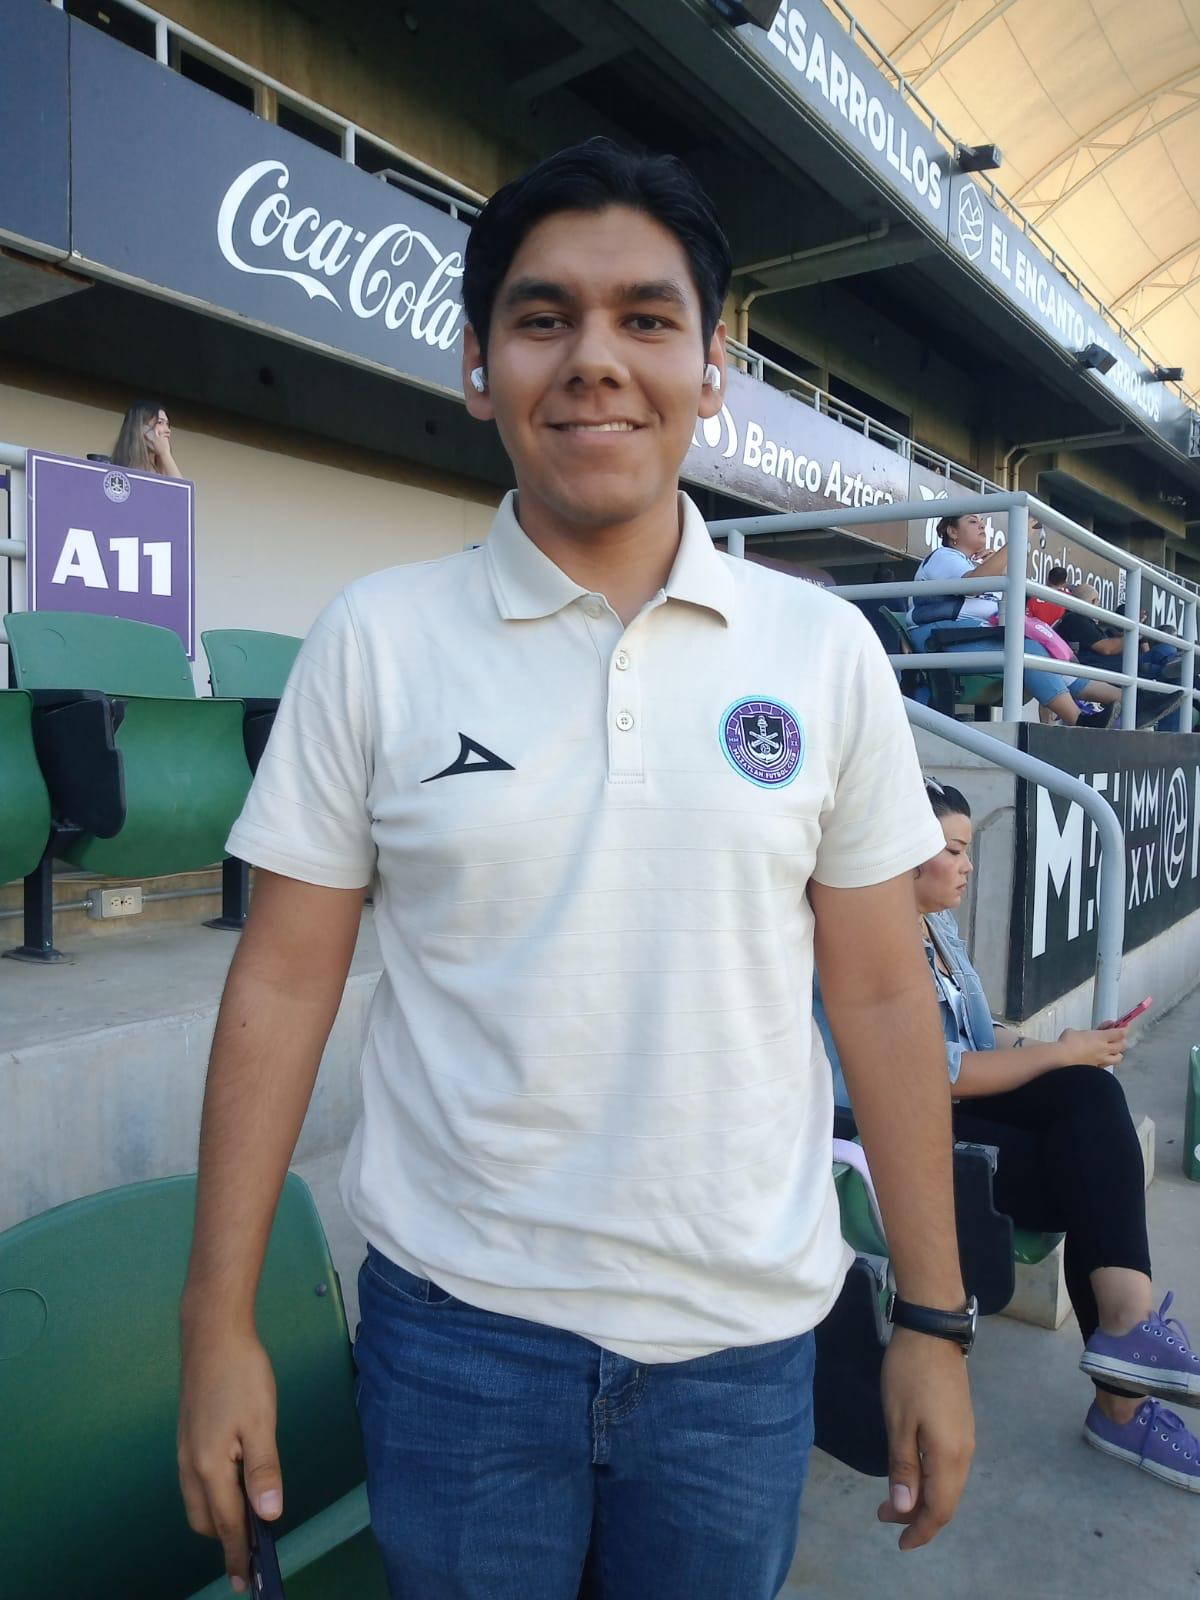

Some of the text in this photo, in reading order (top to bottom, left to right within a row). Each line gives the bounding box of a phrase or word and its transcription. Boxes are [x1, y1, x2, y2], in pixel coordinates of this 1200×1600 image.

[767, 0, 942, 210] ESARROLLOS
[217, 159, 464, 351] Coca-Cola
[990, 223, 1011, 280] EL
[1015, 252, 1085, 347] ENCANTO
[743, 420, 894, 508] Banco Azte
[51, 527, 172, 597] A11
[1130, 767, 1160, 832] MM
[1128, 842, 1156, 911] XX
